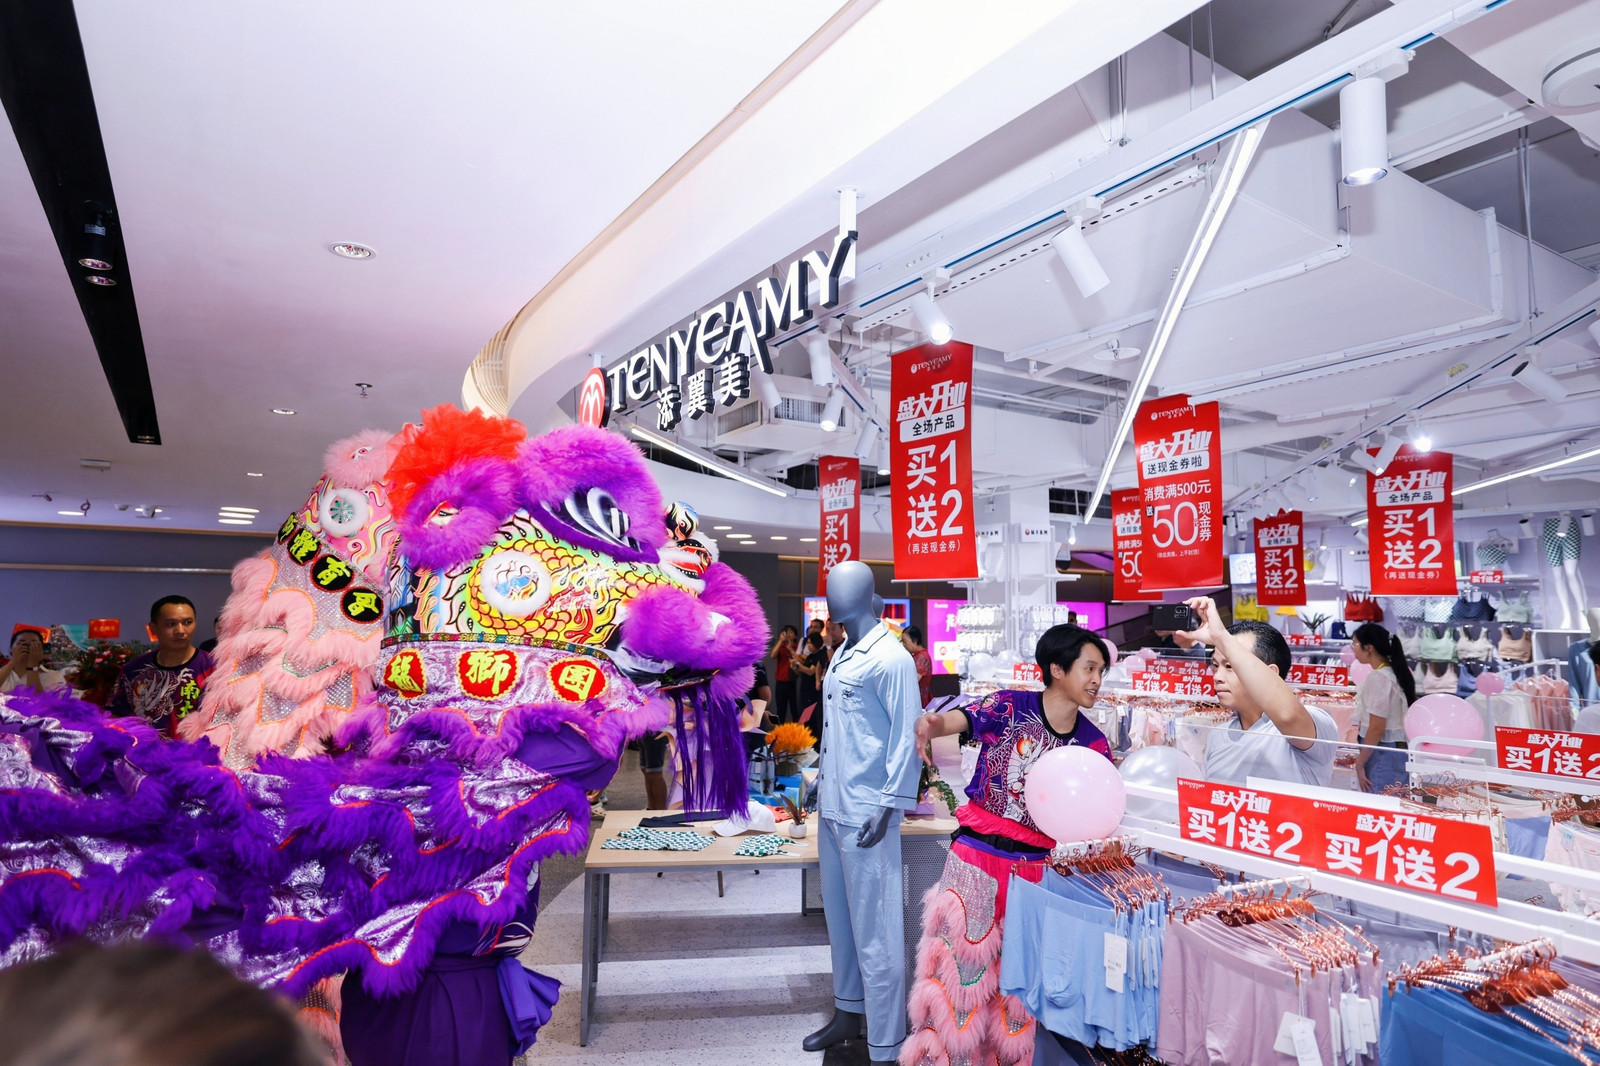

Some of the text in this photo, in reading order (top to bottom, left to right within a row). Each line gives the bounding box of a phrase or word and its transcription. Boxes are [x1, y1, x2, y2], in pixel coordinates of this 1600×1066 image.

[607, 231, 858, 412] TENYEAMY
[656, 353, 750, 431] 添翼美
[896, 380, 967, 422] 盛大开业
[913, 414, 955, 437] 全场产品
[1140, 428, 1212, 462] 盛大开业
[907, 440, 957, 490] 买1
[1147, 455, 1202, 475] 送现金券啦
[1144, 479, 1211, 502] 消费满500元
[1373, 469, 1447, 493] 盛大开业
[1389, 491, 1433, 503] 全场产品
[907, 489, 963, 539] 送2
[1198, 501, 1211, 542] 现金券
[1383, 507, 1436, 538] 买1
[1257, 523, 1299, 538] 盛大开业
[1264, 548, 1294, 568] 买1
[1383, 539, 1443, 569] 送2
[1264, 568, 1298, 589] 送2
[1135, 679, 1169, 692] 买1送2
[1174, 682, 1212, 696] 买1送2
[1307, 672, 1345, 686] 买1送2
[1527, 733, 1583, 749] 盛大开业
[1211, 790, 1271, 814] 盛大开业
[1188, 806, 1303, 862] 买1送2
[1355, 813, 1437, 843] 盛大开业
[1325, 831, 1480, 900] 买1送2
